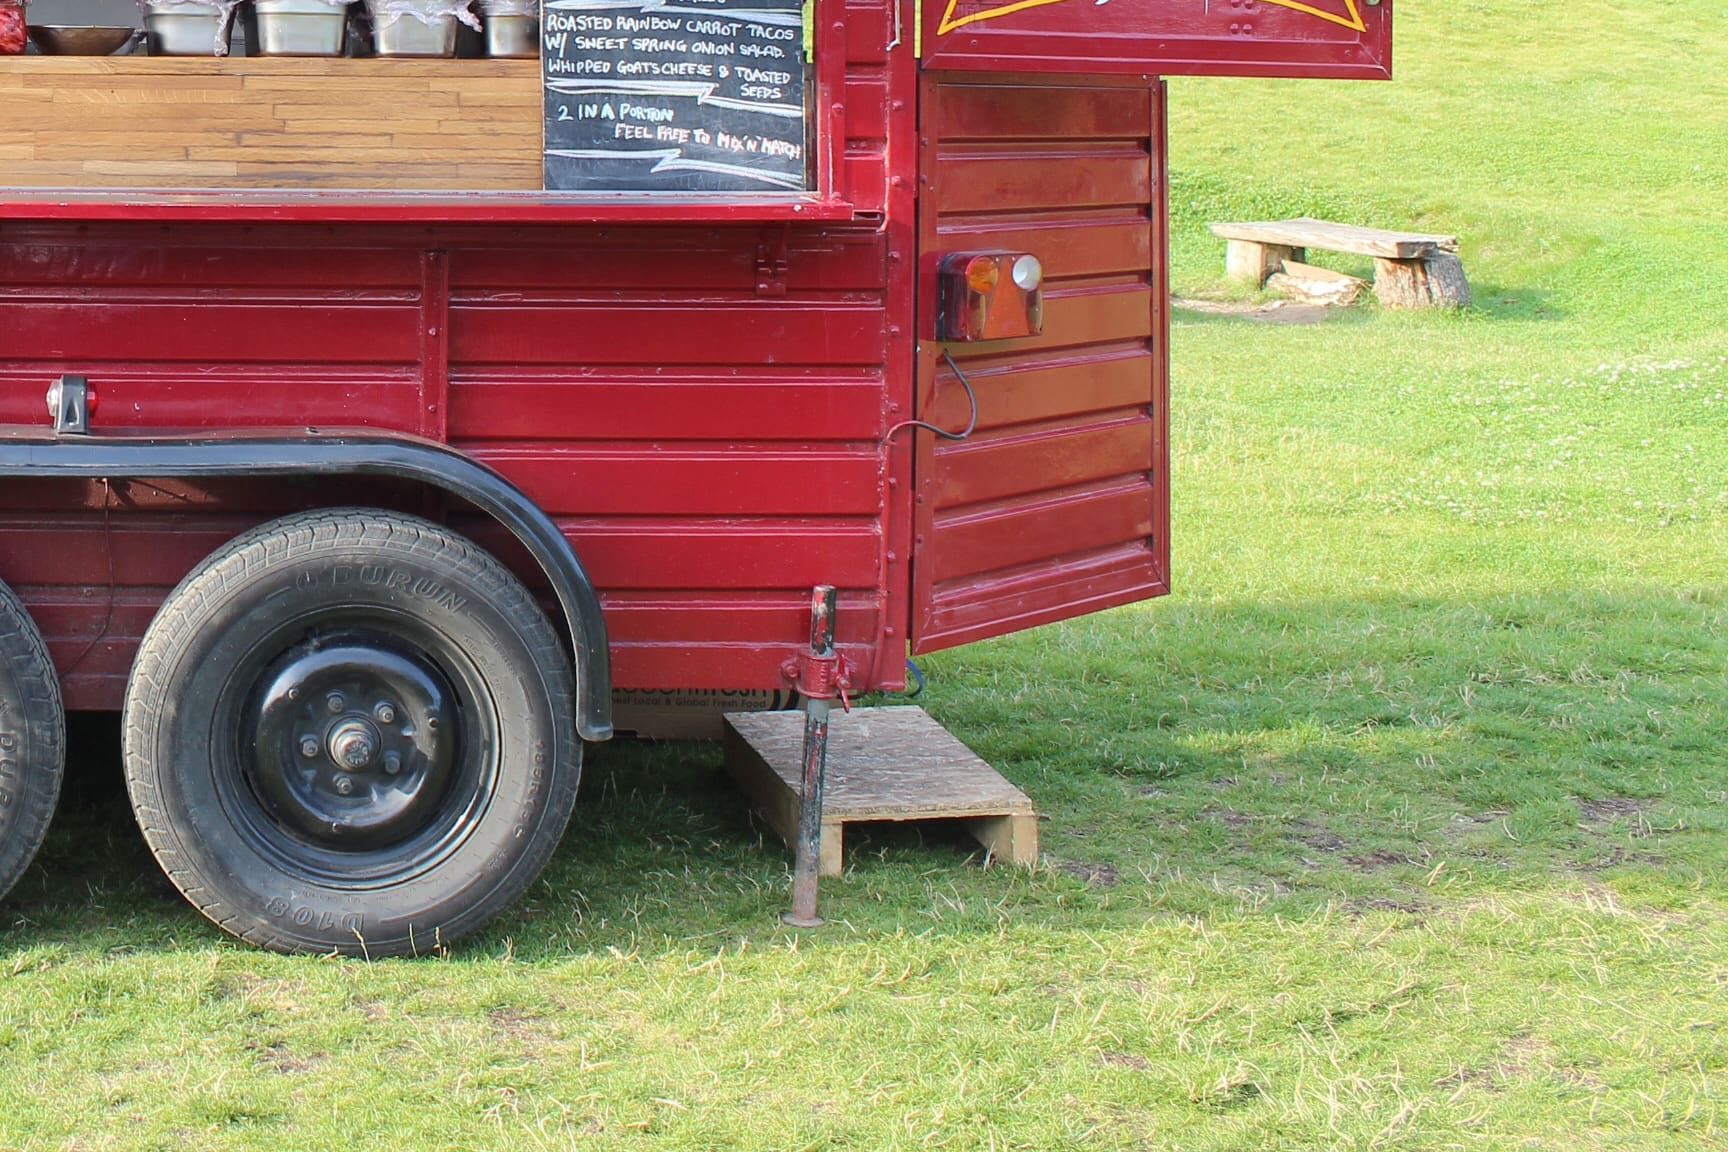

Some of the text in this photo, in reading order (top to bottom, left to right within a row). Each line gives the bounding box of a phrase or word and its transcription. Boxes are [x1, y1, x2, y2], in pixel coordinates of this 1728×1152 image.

[547, 15, 794, 40] ROASTED RAINBOW CARROT TACOS
[544, 32, 567, 58] W/
[575, 36, 628, 50] SWEET
[632, 38, 688, 52] SPRING
[692, 41, 734, 56] ONION
[548, 58, 611, 74] WHIPPED
[734, 66, 791, 85] TOASTED
[740, 83, 782, 98] SEEDS
[558, 103, 674, 123] 2 IN A PORTION
[615, 122, 653, 139] FEEL
[657, 125, 691, 144] FREE
[693, 128, 710, 144] TO
[333, 565, 466, 615] DURUN
